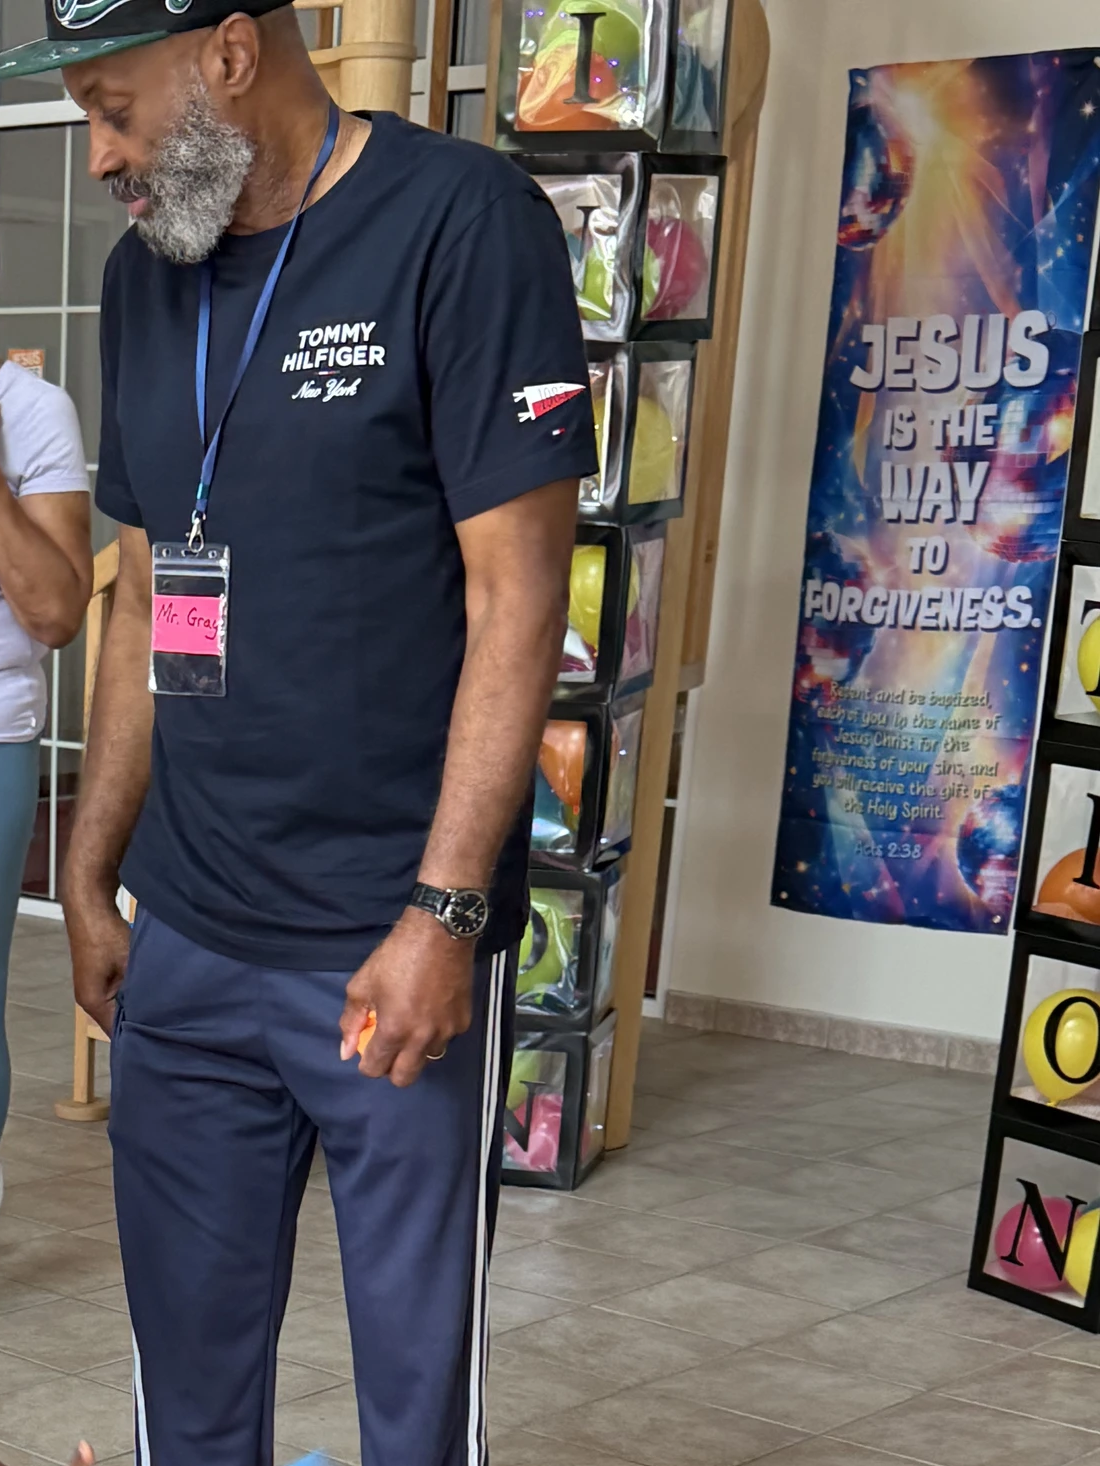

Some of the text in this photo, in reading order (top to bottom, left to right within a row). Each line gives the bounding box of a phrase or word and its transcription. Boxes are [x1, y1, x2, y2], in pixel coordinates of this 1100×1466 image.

[298, 321, 377, 350] TOMMY
[281, 345, 386, 373] HILFIGER
[850, 309, 1050, 392] JESUS
[291, 377, 362, 402] New York
[883, 403, 998, 450] IS THE
[881, 461, 990, 525] WAY
[907, 536, 949, 575] TO
[804, 578, 1042, 632] FORGIVENESS.
[156, 602, 219, 640] Mr. Gray
[875, 689, 905, 704] and
[909, 690, 926, 705] be
[862, 710, 887, 727] you
[913, 713, 936, 729] the
[940, 718, 980, 730] name
[986, 715, 1003, 730] of
[835, 728, 970, 753] Jesus Christ for the
[879, 756, 897, 771] of
[898, 761, 929, 776] your
[935, 760, 965, 778] sins,
[970, 762, 999, 776] and
[812, 773, 831, 788] you
[857, 778, 905, 794] receive
[910, 780, 936, 797] the
[940, 783, 969, 801] gift
[973, 785, 991, 799] of
[844, 800, 944, 820] the Holy Spirit.
[854, 842, 922, 859] Acts 2:38
[1000, 1177, 1088, 1282] N
